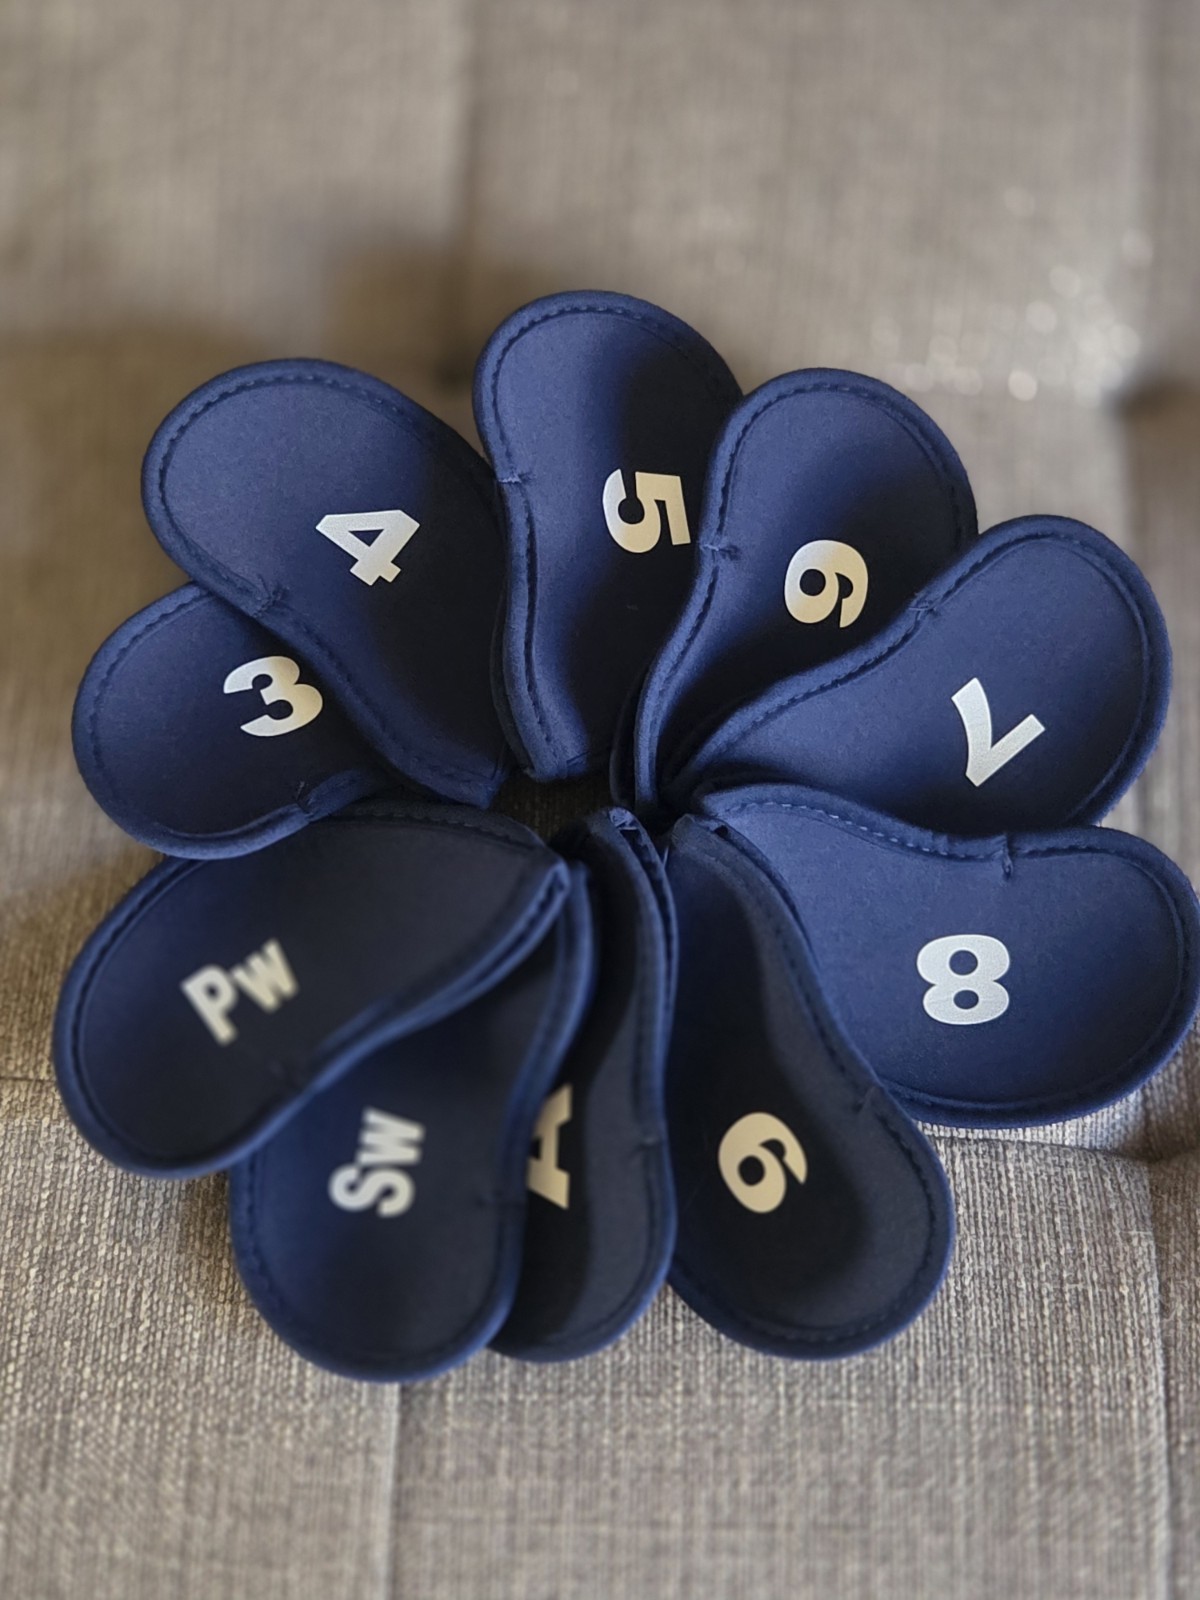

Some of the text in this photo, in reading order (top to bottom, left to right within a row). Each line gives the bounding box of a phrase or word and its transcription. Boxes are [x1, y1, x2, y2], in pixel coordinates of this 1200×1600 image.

[315, 509, 420, 586] 4
[602, 468, 691, 554] 5
[783, 539, 869, 628] 6
[222, 655, 323, 737] 3
[950, 676, 1046, 787] 7
[915, 933, 1011, 1026] 8
